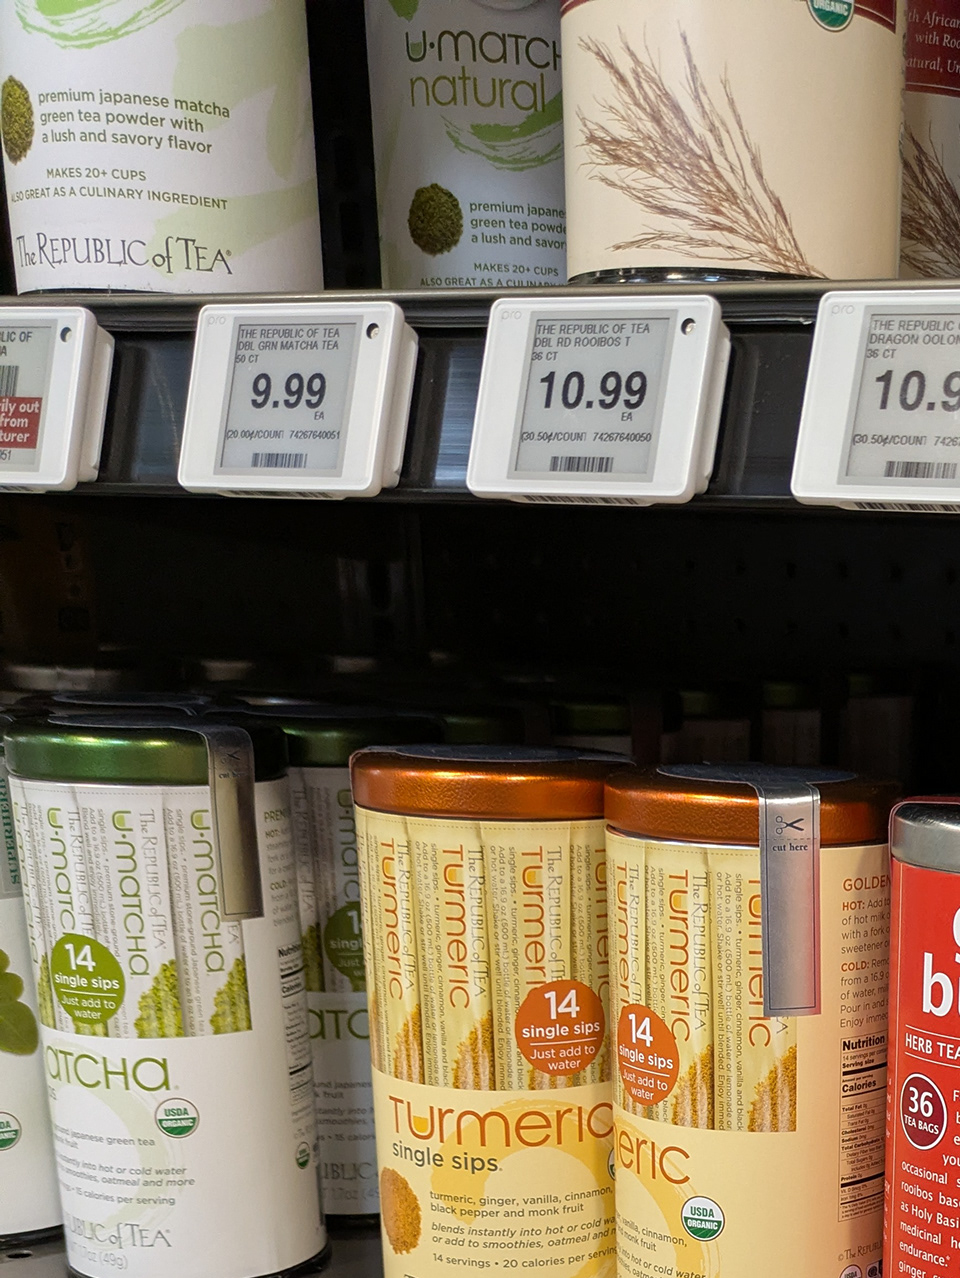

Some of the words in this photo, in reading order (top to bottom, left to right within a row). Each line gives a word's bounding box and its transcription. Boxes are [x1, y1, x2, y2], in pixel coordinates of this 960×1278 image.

[410, 66, 546, 112] natural
[38, 89, 95, 105] premium
[99, 89, 169, 107] japanese
[175, 98, 230, 118] matcha
[40, 110, 74, 125] green
[78, 109, 101, 122] tea
[106, 111, 165, 127] powder
[170, 117, 204, 132] with
[42, 133, 49, 143] a
[51, 130, 76, 143] lush
[80, 130, 106, 143] and
[112, 132, 163, 149] savory
[168, 135, 212, 153] flavor
[37, 232, 149, 269] REPUBLIC
[152, 236, 173, 273] of
[240, 329, 258, 339] THE
[261, 328, 303, 339] REPUBLIC
[306, 328, 320, 338] OF
[323, 328, 340, 338] TEA
[869, 334, 919, 345] DRAGON
[259, 341, 278, 351] GRN
[280, 340, 319, 351] MATCHA
[322, 340, 339, 350] TEA
[248, 354, 259, 363] CT
[252, 372, 326, 409] 9.99
[541, 371, 647, 409] 10.99
[64, 943, 96, 972] 14
[54, 972, 87, 989] single
[92, 976, 120, 991] sips
[544, 989, 580, 1020] 14
[522, 1025, 569, 1039] single
[573, 1021, 600, 1036] sips
[905, 1033, 932, 1054] HERB
[161, 1118, 194, 1128] ORGANIC
[164, 1108, 189, 1117] USDA
[392, 1140, 444, 1167] single
